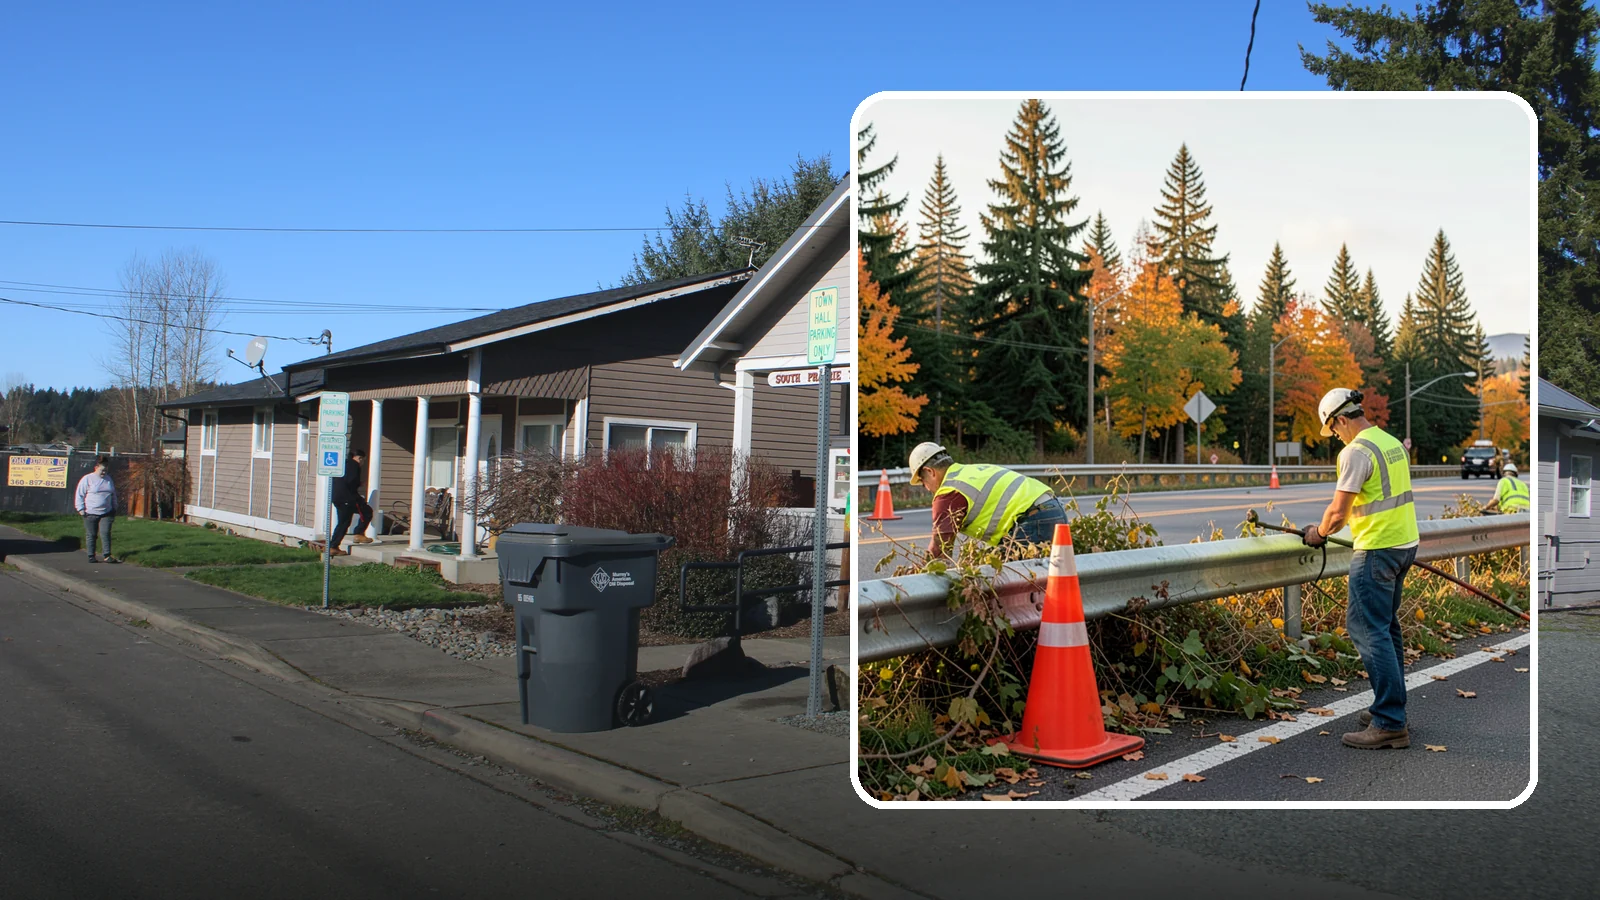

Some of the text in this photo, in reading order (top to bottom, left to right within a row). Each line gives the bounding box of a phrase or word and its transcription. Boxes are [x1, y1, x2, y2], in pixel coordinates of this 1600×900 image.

[815, 295, 833, 308] TOWN
[815, 311, 831, 324] HALL
[809, 326, 836, 341] PARKING
[813, 344, 831, 357] ONLY
[775, 373, 801, 384] SOUTH
[322, 409, 345, 417] PARKING
[325, 420, 340, 428] ONLY
[320, 436, 344, 444] RESERVED
[321, 443, 343, 451] PARKING
